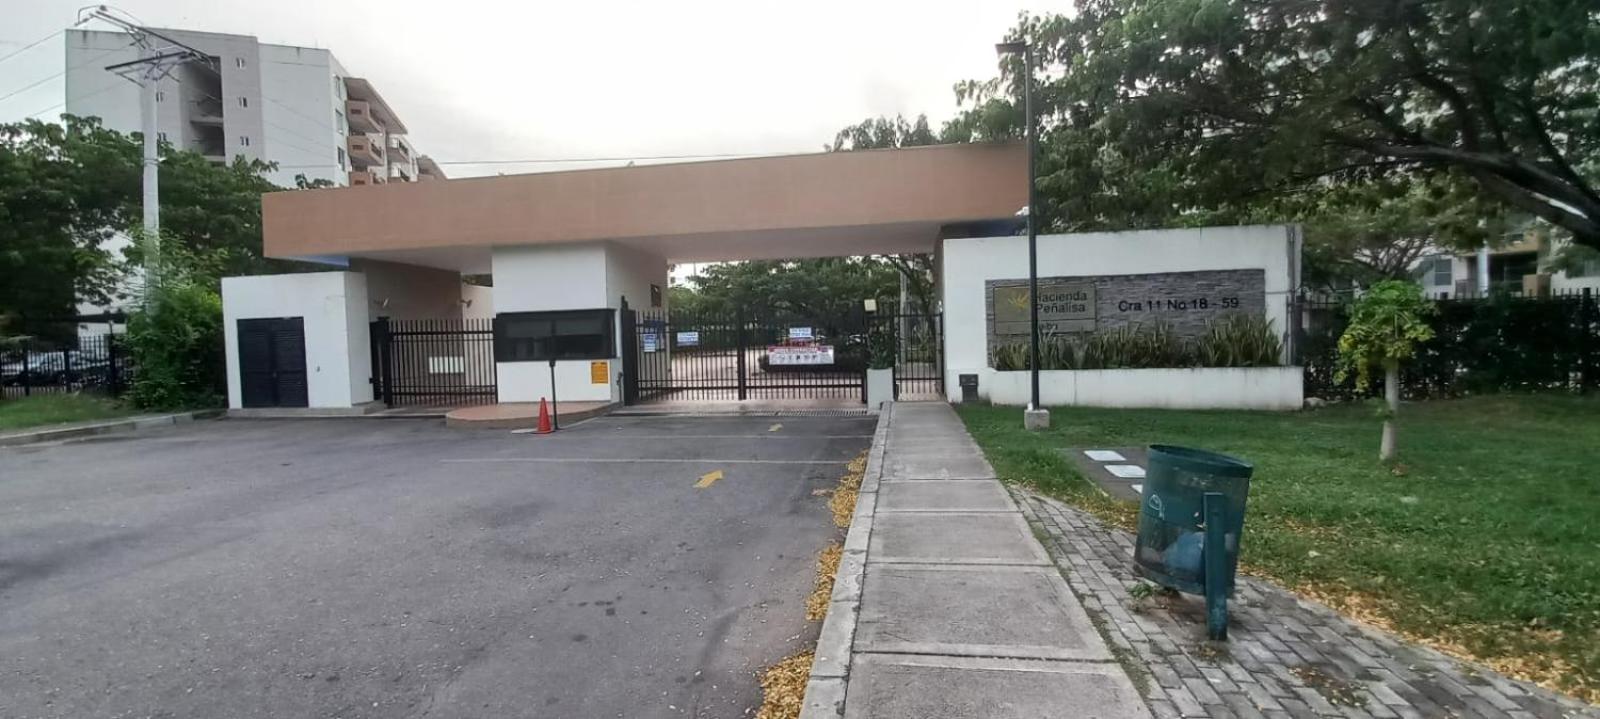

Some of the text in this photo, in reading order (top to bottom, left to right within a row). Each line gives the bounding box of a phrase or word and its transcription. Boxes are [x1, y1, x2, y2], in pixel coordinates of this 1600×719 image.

[1036, 302, 1086, 314] Peñalisa
[1118, 300, 1142, 312] Cra
[1147, 300, 1161, 312] 11
[1191, 298, 1208, 310] 18
[1221, 297, 1239, 309] 59
